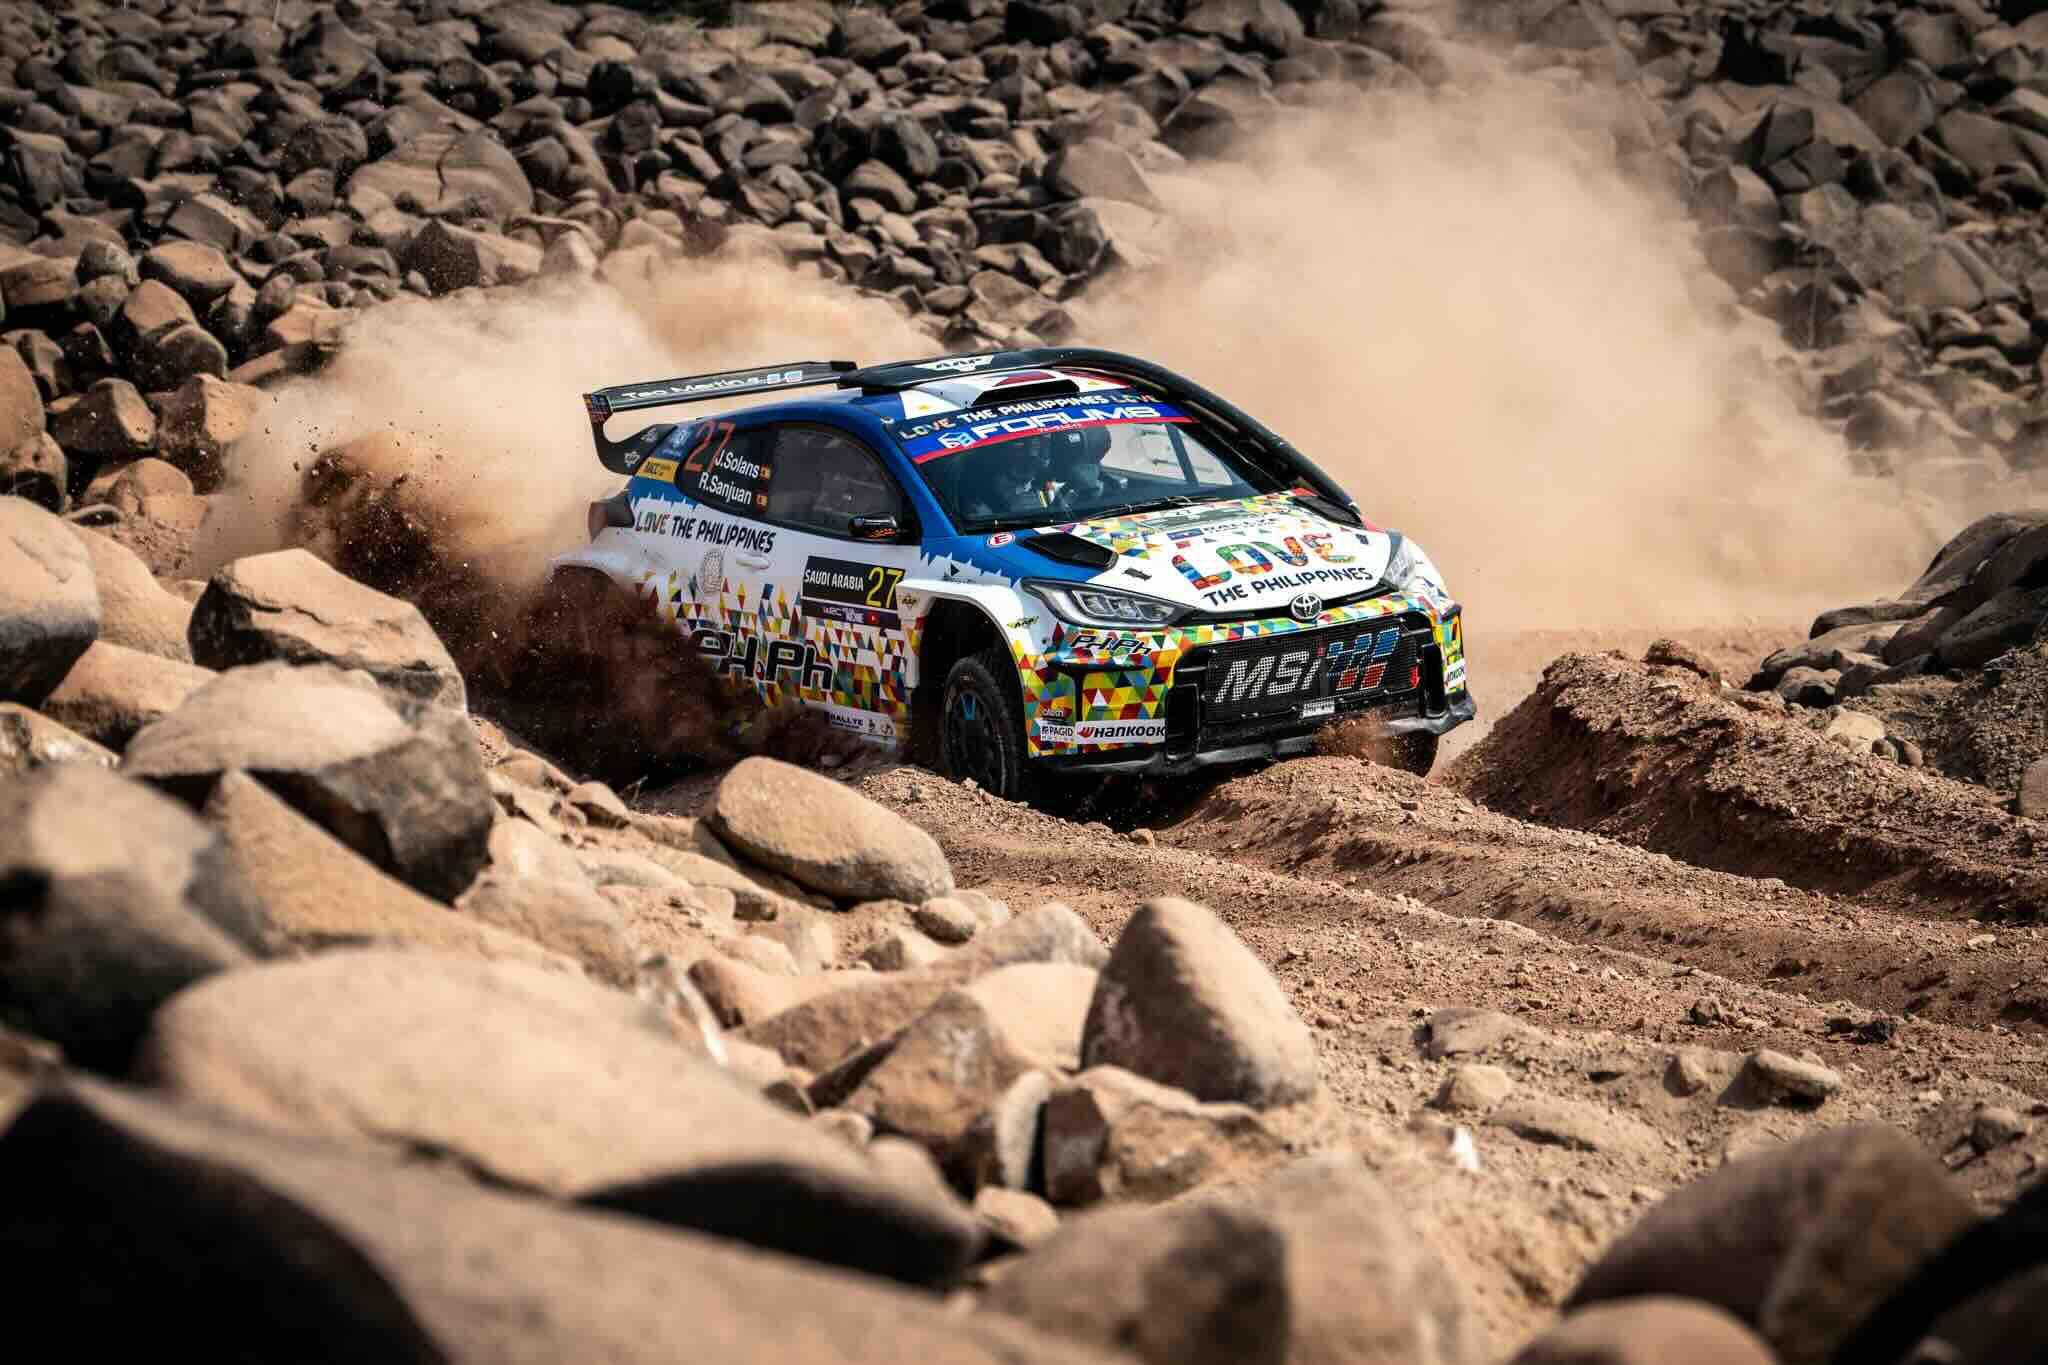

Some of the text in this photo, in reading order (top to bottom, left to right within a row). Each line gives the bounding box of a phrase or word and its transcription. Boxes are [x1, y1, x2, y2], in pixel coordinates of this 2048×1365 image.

[900, 418, 957, 439] LOVE
[957, 409, 998, 424] THE
[998, 395, 1110, 416] PHILIPPINES
[684, 420, 737, 473] 27
[715, 447, 761, 478] J.Solans
[698, 471, 752, 505] R.Sanjuan
[635, 511, 777, 553] LOVE THE PHILIPPINES
[1171, 531, 1356, 590] LOVE
[804, 566, 904, 609] SAUDI ARABIA 27
[1201, 567, 1374, 607] THE PHILIPPINES
[1049, 725, 1074, 737] PAGID
